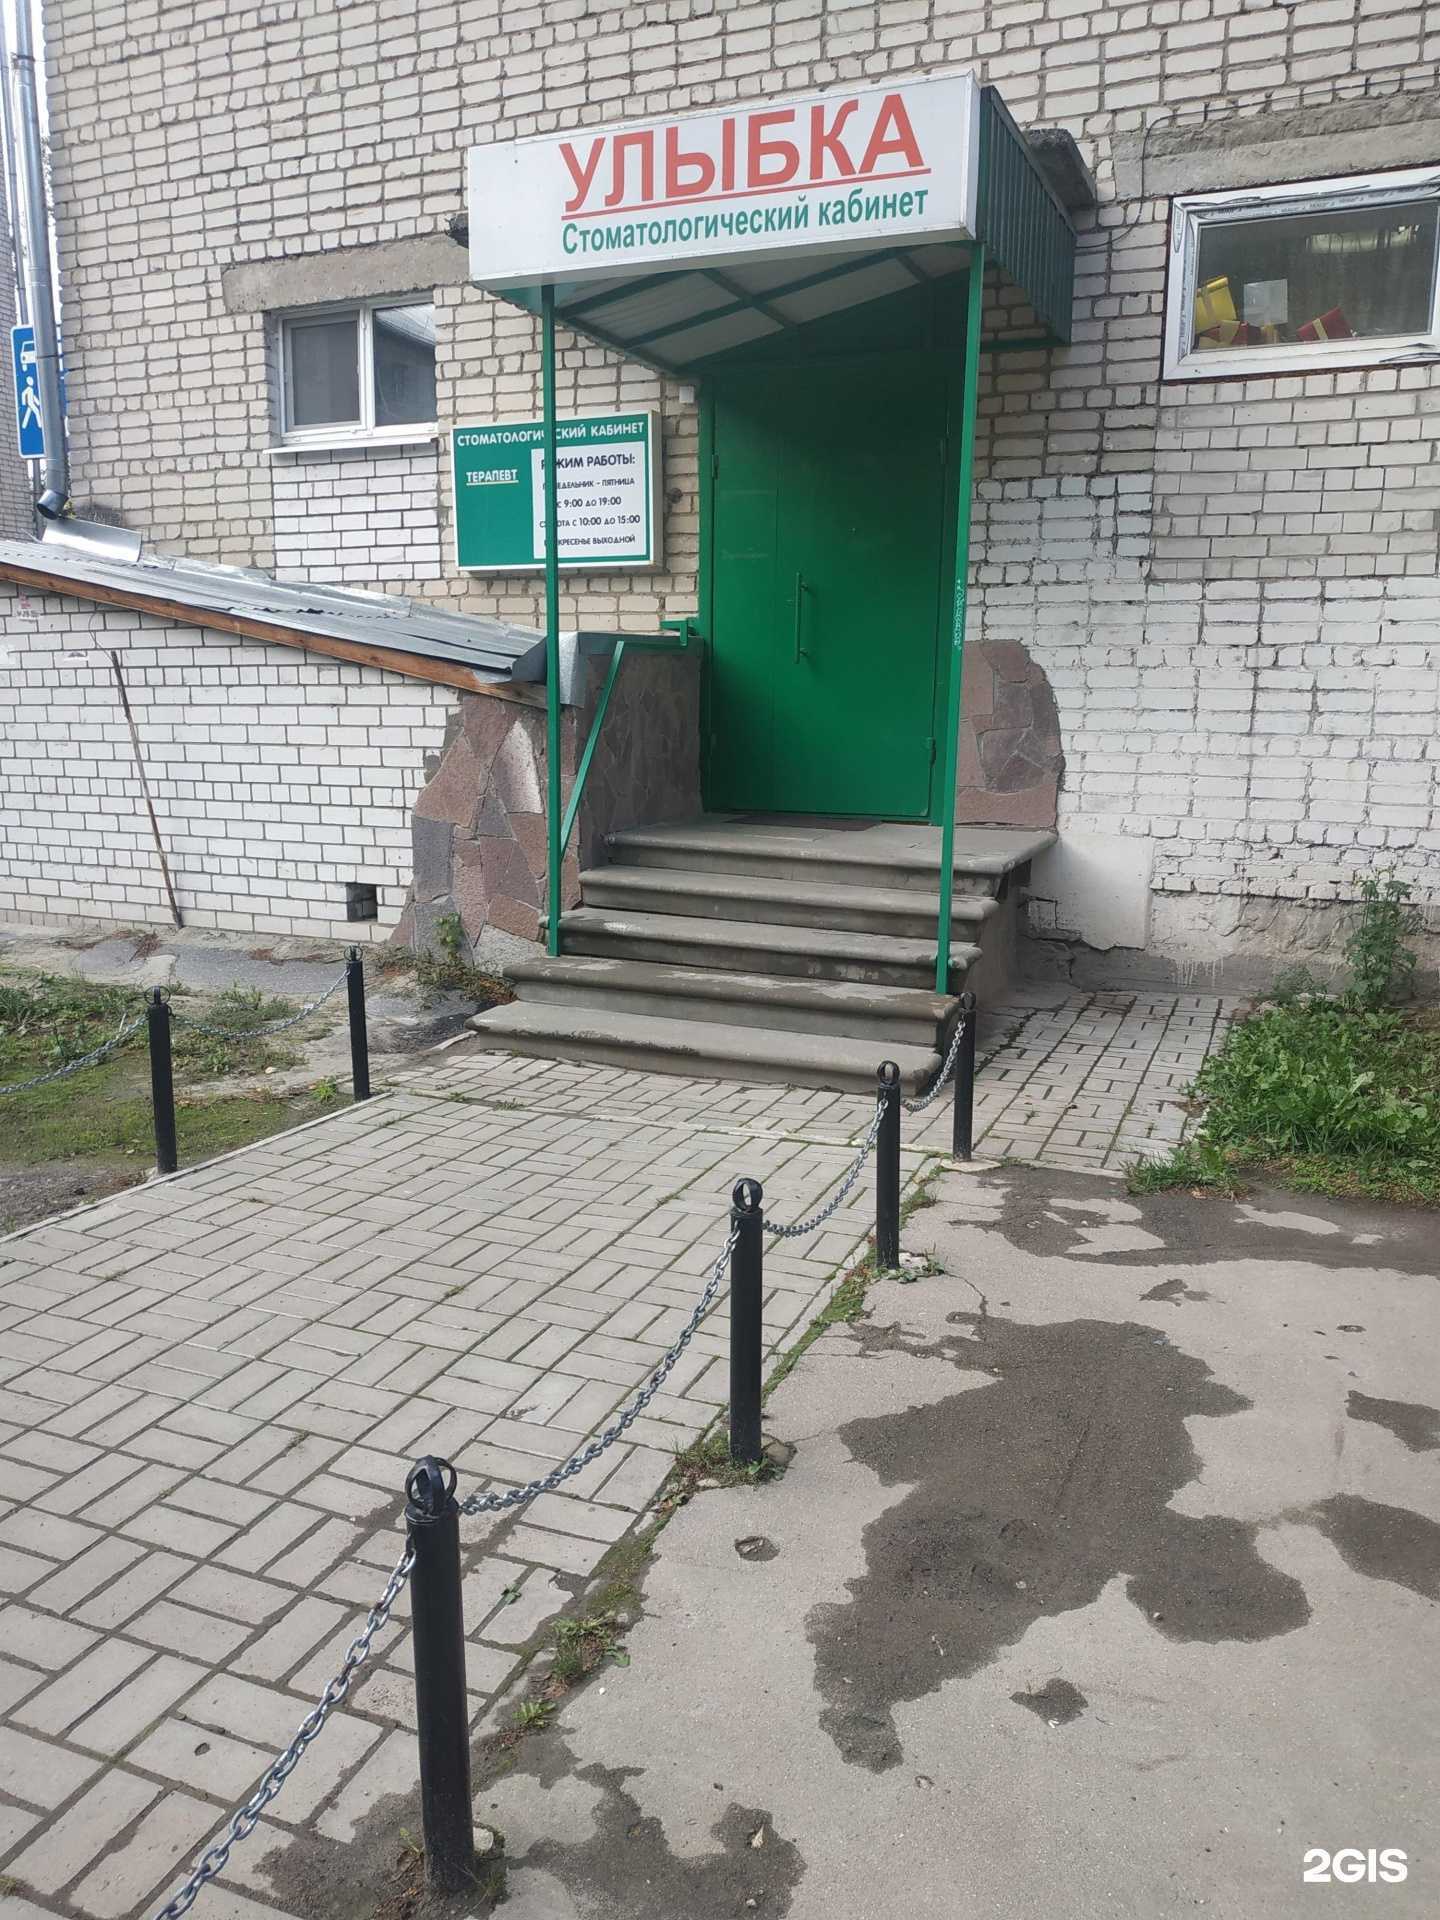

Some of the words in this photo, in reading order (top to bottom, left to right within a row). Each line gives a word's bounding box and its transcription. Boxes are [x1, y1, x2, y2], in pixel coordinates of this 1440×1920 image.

[559, 94, 924, 212] УЛЫБКА
[563, 195, 808, 254] Стоматологический
[819, 188, 928, 226] кабинет
[591, 422, 644, 437] КАБИНЕТ
[587, 453, 636, 467] РАБОТЫ:
[466, 469, 518, 483] ТЕРАПЕВТ
[602, 478, 635, 486] ПЯТНИЦА
[564, 499, 583, 508] 9:00
[599, 496, 622, 506] 19:00
[579, 517, 602, 527] 10:00
[617, 514, 641, 524] 15:00
[592, 534, 636, 545] ВЫХОДНОЙ
